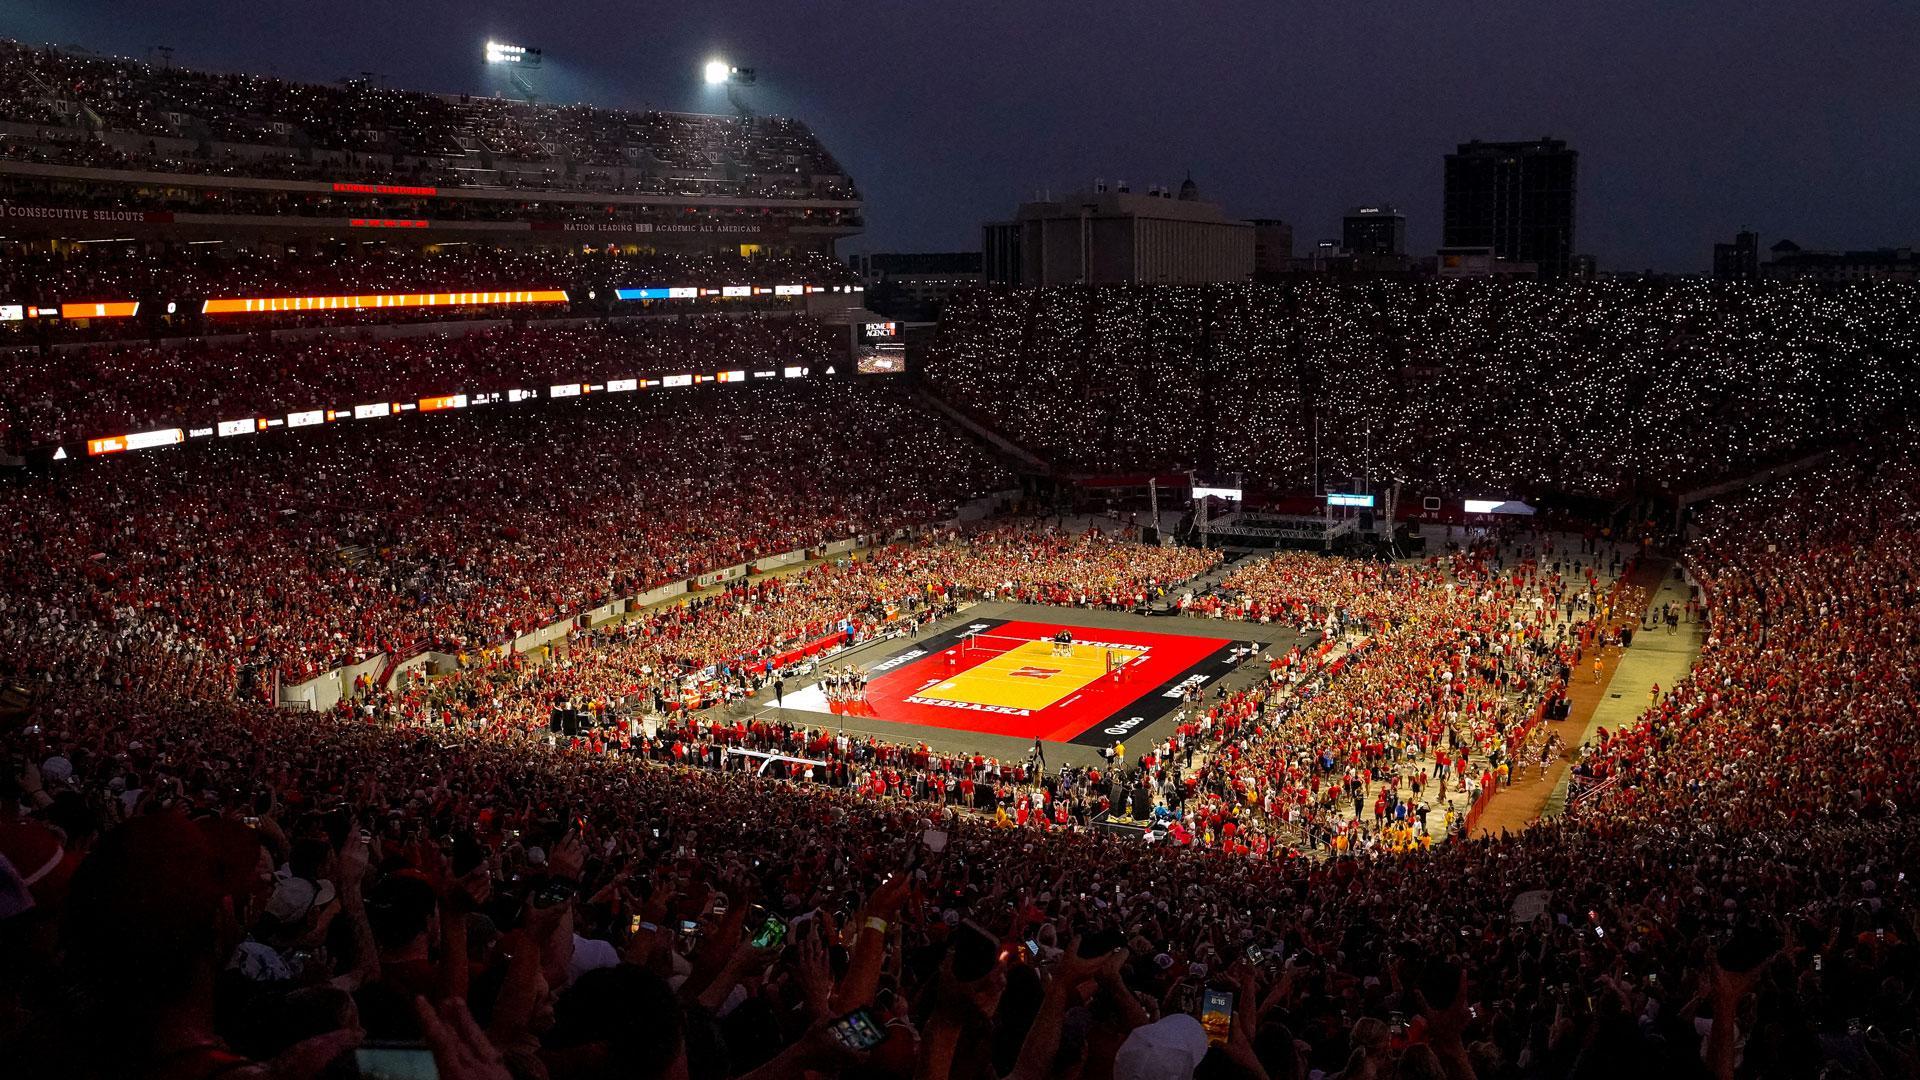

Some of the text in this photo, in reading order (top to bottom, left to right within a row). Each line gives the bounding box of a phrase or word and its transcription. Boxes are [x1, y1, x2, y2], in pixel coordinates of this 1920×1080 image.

[8, 206, 145, 222] CONSECUTIVE SELLOUTS
[564, 223, 595, 232] NATION
[598, 223, 632, 232] LEADING
[656, 224, 696, 233] ACADEMIC
[700, 225, 713, 233] ALL
[717, 225, 761, 233] AMERICANS
[866, 329, 891, 337] AGENCY
[1040, 636, 1153, 651] NEBRASA
[1009, 666, 1062, 679] N
[902, 695, 1030, 717] NEBRASKA
[1210, 997, 1226, 1006] 8:16
